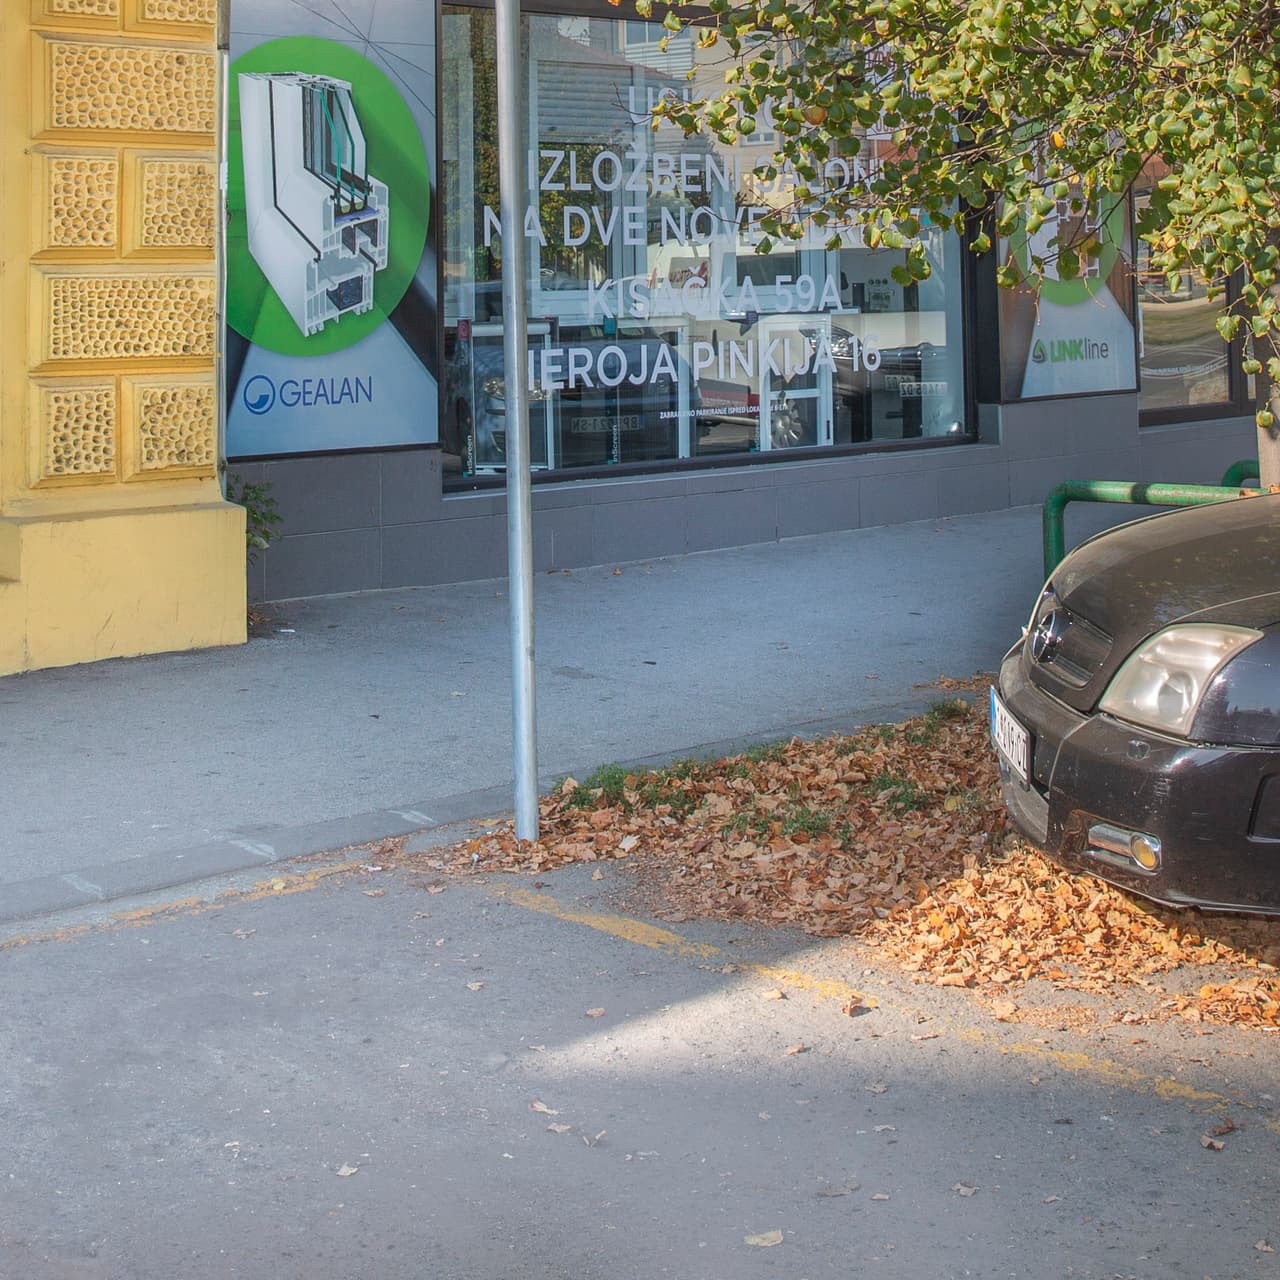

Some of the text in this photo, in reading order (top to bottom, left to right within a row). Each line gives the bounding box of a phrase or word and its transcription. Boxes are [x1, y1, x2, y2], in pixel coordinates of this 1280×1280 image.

[528, 142, 740, 193] IZLOŽBENI
[563, 205, 645, 247] DVE
[661, 206, 770, 248] NOVE
[587, 266, 844, 320] KISAČKA 59A
[692, 337, 838, 382] PINKIJA
[848, 335, 881, 372] 16
[279, 375, 373, 407] GEALAN
